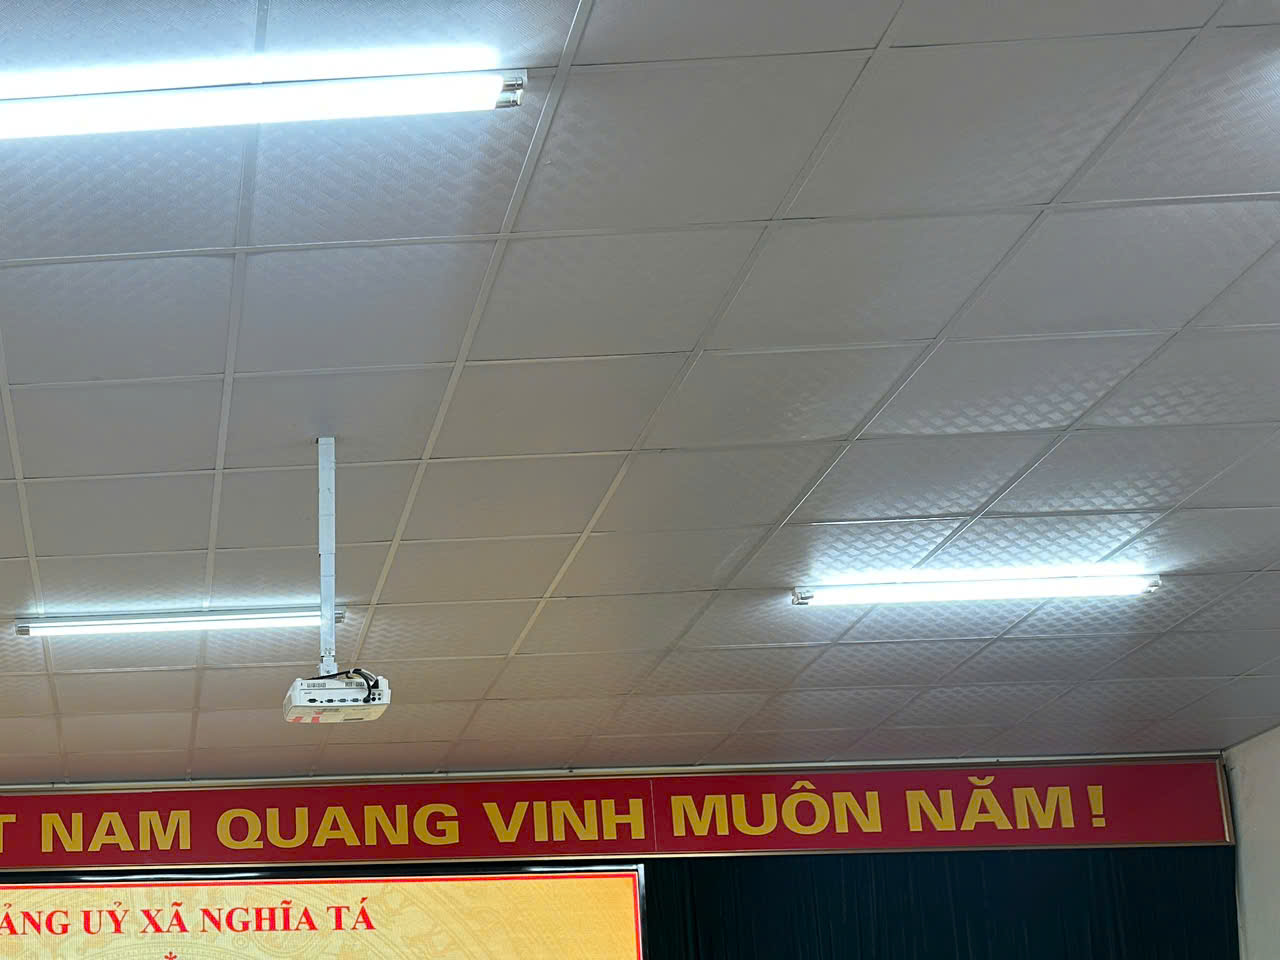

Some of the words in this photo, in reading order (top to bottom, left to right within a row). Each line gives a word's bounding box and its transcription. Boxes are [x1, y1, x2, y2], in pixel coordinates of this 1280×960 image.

[40, 810, 191, 852] NAM
[216, 804, 460, 849] QUANG
[483, 798, 645, 843] VINH
[670, 780, 883, 837] MUÔN
[905, 776, 1075, 832] NĂM
[80, 901, 128, 935] UỶ
[140, 902, 189, 934] XÃ
[200, 900, 319, 933] NGHĨA
[326, 897, 376, 932] TÁ
